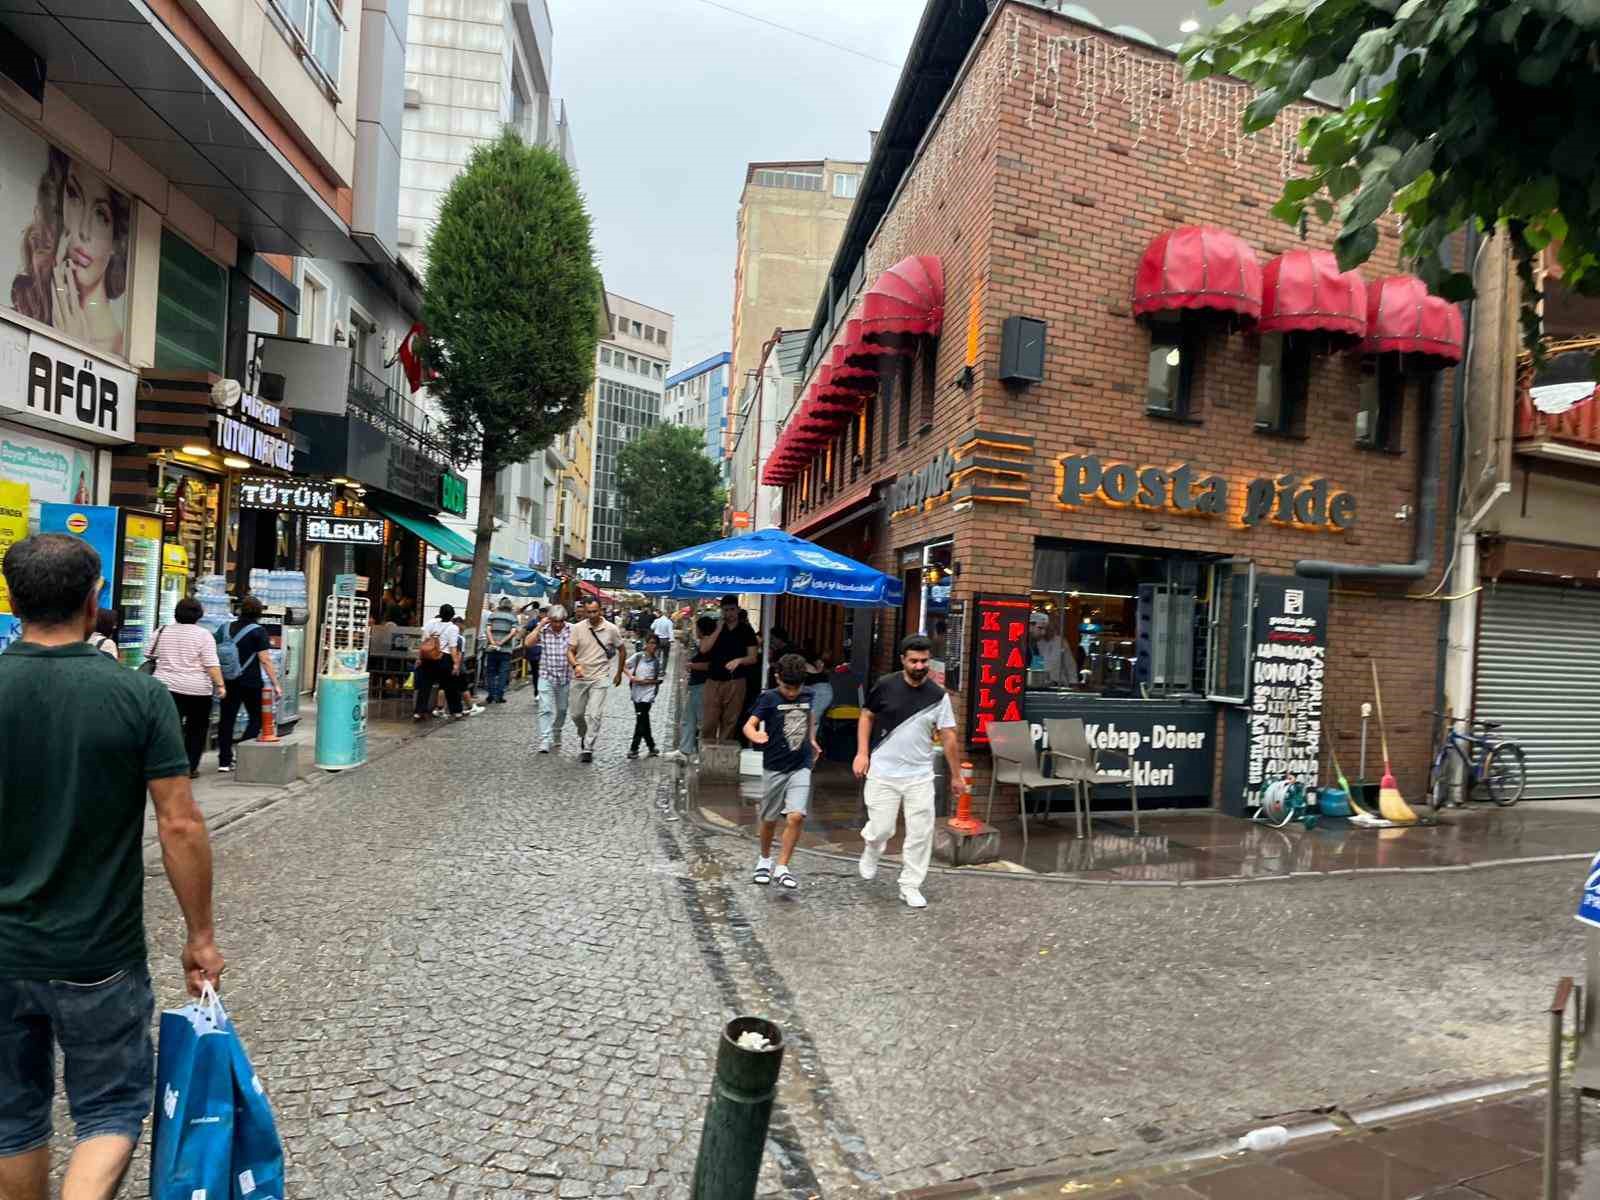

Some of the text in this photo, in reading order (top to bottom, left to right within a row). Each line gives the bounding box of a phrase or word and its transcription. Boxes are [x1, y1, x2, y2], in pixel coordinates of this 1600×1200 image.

[27, 351, 119, 432] AFÖR
[1059, 453, 1358, 530] posta pide
[309, 519, 380, 541] BİLEKLİK
[1030, 723, 1049, 748] Pi
[1084, 723, 1141, 755] Kebap
[1151, 725, 1206, 749] Döner
